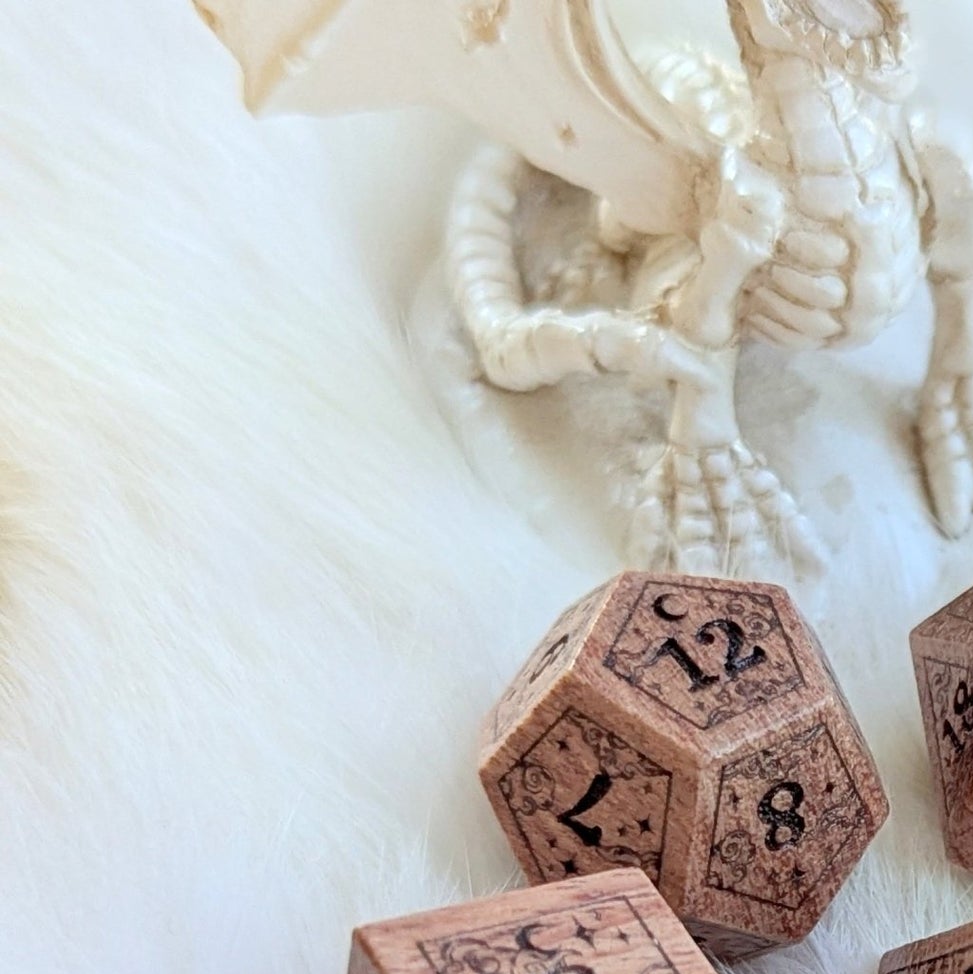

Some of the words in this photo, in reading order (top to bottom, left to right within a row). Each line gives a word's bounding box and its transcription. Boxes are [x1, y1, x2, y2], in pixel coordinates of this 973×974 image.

[648, 618, 767, 692] 12
[558, 772, 613, 846] 7
[758, 781, 805, 851] 8
